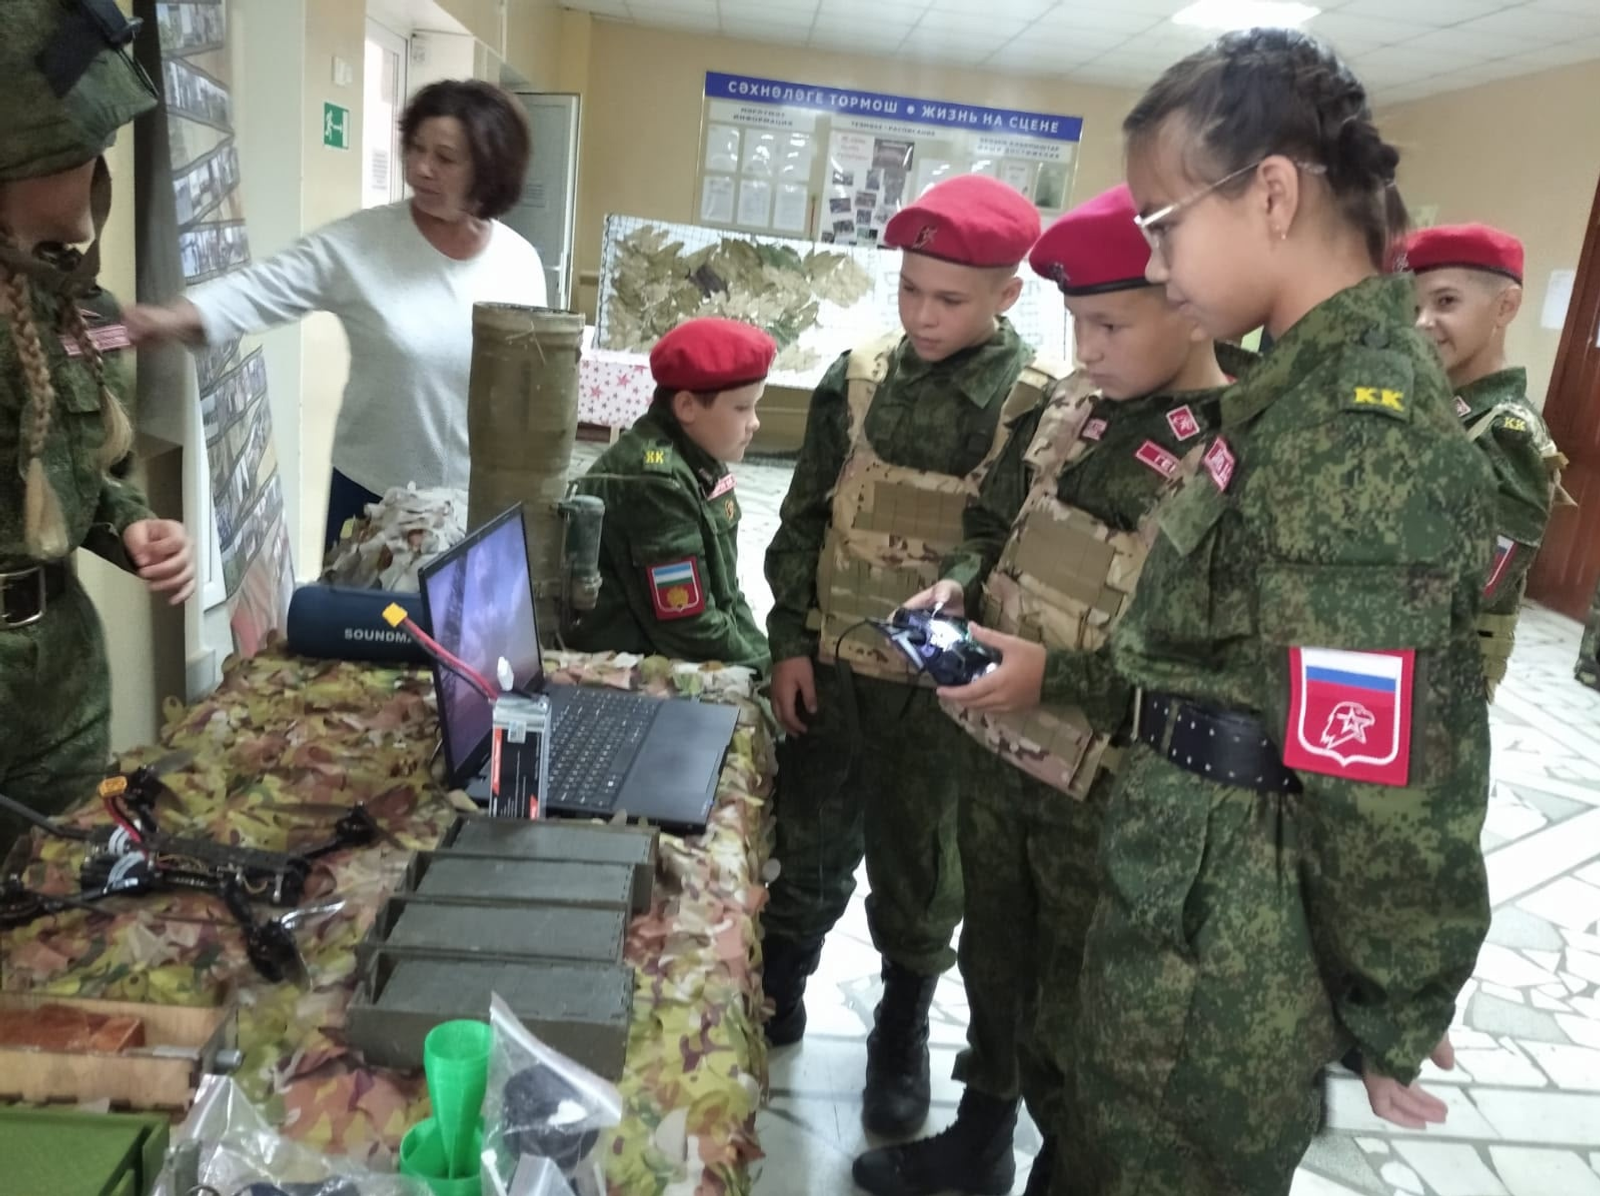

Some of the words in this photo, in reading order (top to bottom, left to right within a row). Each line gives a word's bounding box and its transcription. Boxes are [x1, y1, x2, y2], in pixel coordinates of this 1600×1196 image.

[830, 93, 898, 114] ТОРМОШ
[921, 105, 978, 123] ЖИЗНЬ
[982, 114, 1003, 127] НА
[1009, 116, 1059, 133] СЦЕНЕ
